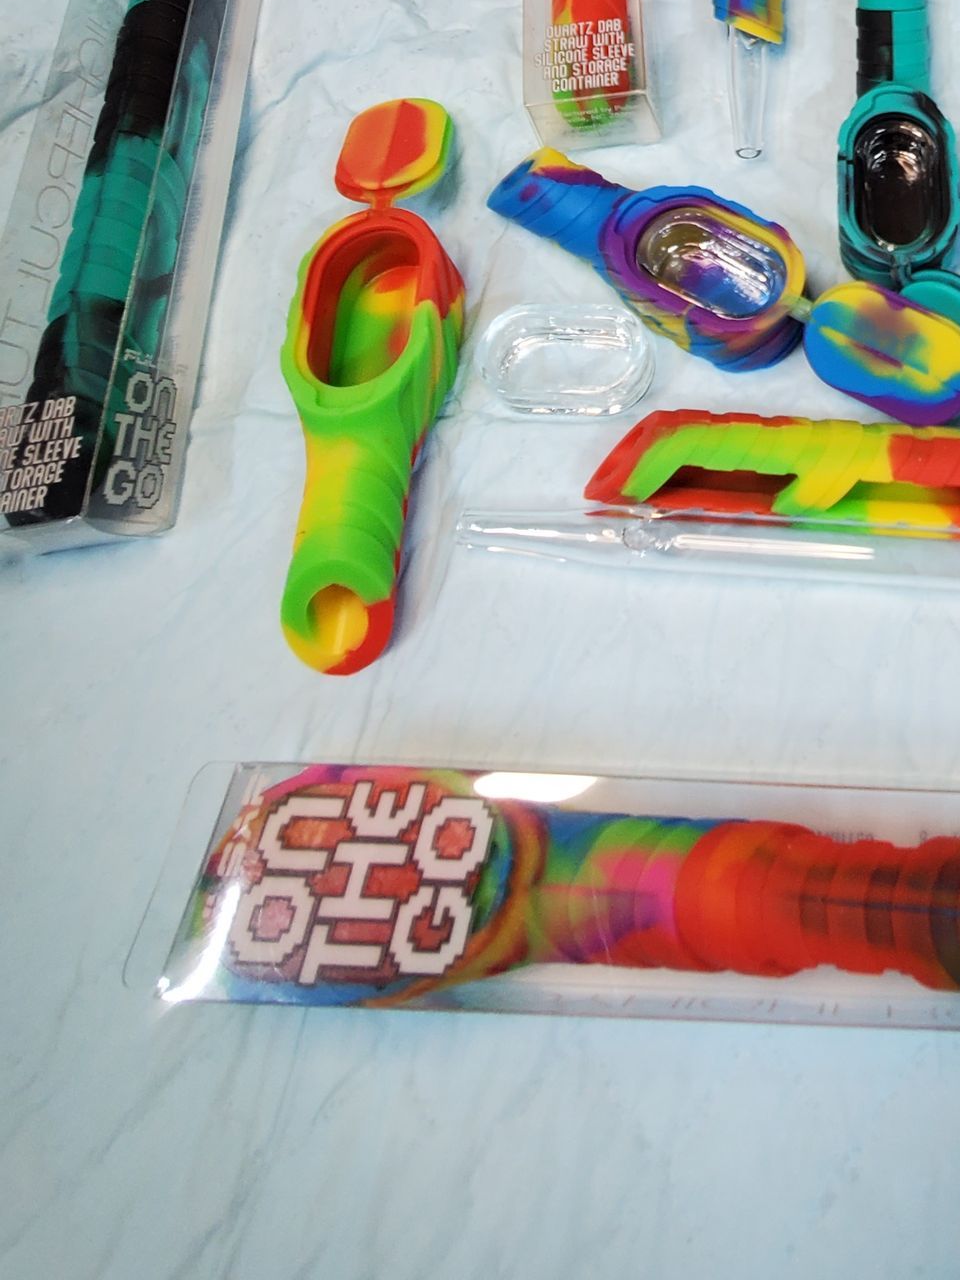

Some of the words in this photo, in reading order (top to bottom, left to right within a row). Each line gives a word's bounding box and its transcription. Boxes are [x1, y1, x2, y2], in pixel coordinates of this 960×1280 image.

[546, 22, 593, 38] QUARTZ
[597, 18, 621, 33] DAB
[544, 35, 588, 52] STRAW
[592, 31, 625, 46] WITH
[535, 48, 588, 66] SILICONE
[592, 43, 635, 60] SLEEVE
[544, 64, 567, 80] AND
[572, 58, 627, 76] STORAGE
[552, 72, 619, 93] CONTAINER
[41, 396, 77, 420] DAB
[29, 416, 75, 443] WITH
[114, 413, 177, 464] THE
[22, 436, 83, 466] SLEEVE
[103, 459, 164, 509] GO
[299, 780, 428, 985] THE
[392, 797, 494, 975] GO
